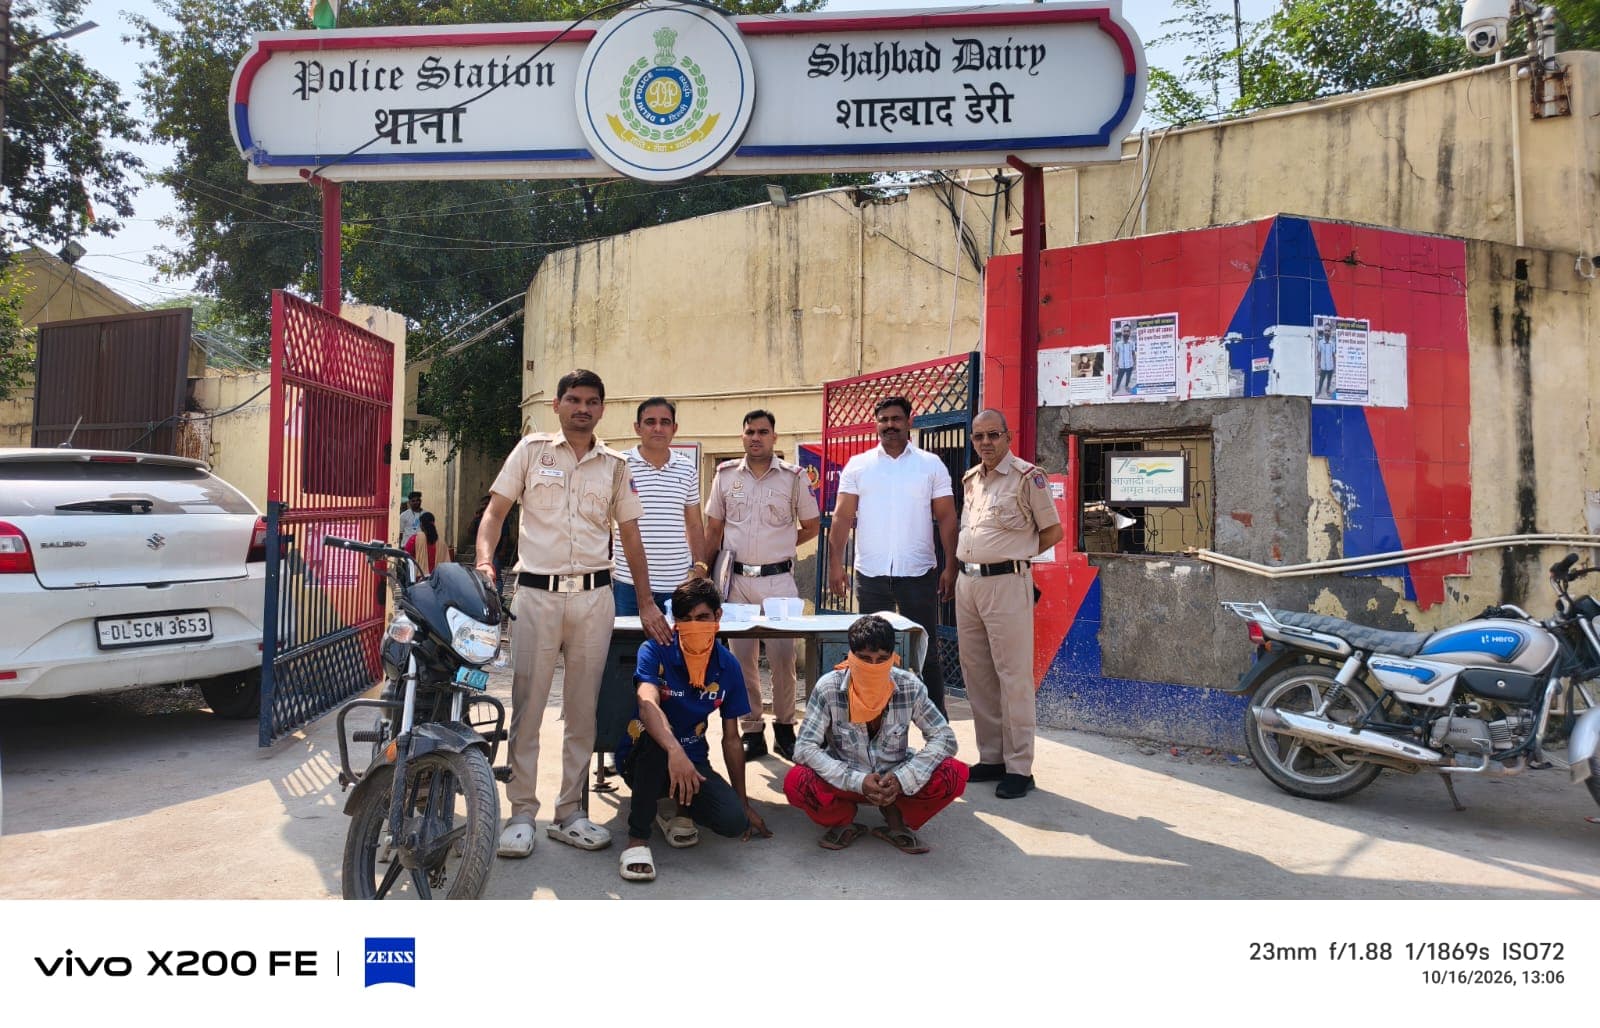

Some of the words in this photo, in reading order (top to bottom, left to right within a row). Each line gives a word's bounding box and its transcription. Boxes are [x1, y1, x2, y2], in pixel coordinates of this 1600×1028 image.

[292, 58, 404, 100] Police
[416, 55, 556, 92] Station
[807, 40, 941, 82] Shahbad
[952, 36, 1047, 77] Dairy
[636, 72, 654, 99] POLICE
[374, 106, 467, 145] थाना
[637, 102, 657, 122] DELHI
[836, 95, 956, 133] शाहबाद
[963, 82, 1015, 125] डेरी
[169, 618, 207, 636] 3653
